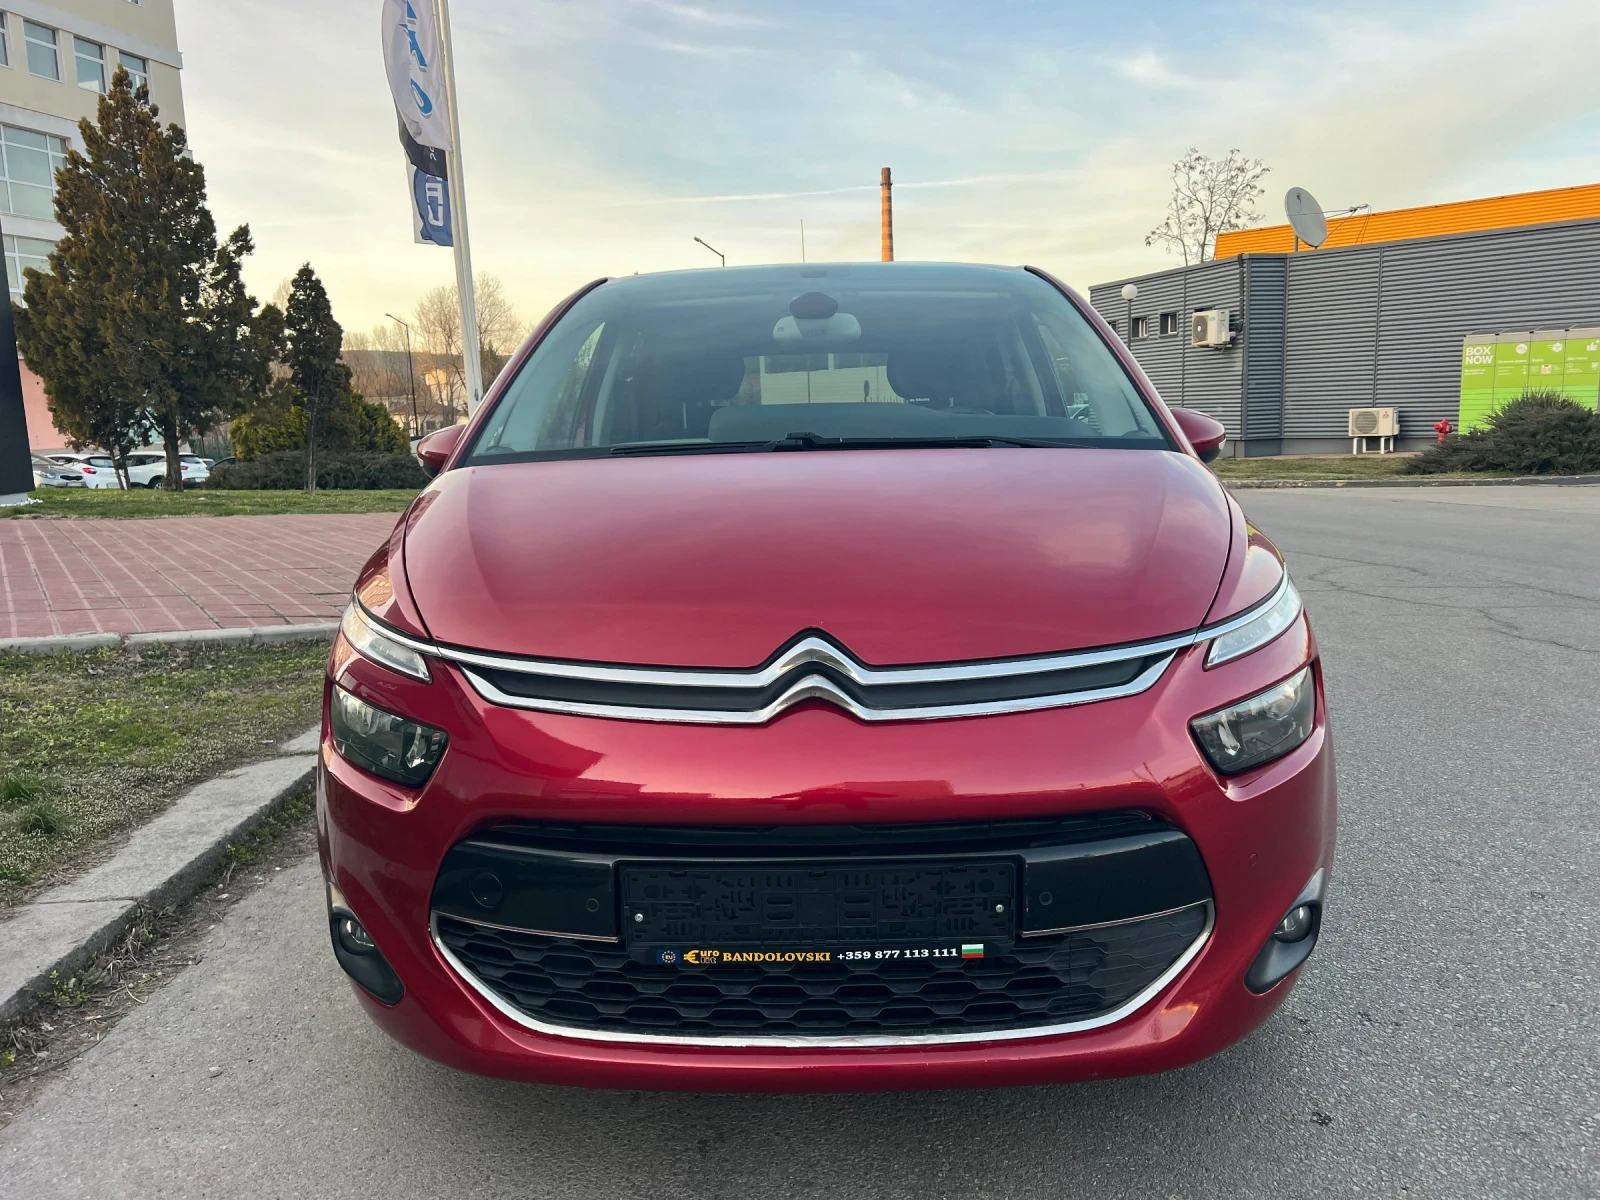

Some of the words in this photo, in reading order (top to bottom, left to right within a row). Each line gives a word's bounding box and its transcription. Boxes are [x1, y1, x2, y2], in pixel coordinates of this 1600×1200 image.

[1466, 346, 1491, 356] BOX
[1465, 355, 1493, 365] NOW
[722, 952, 831, 961] BANDOLOVSKI
[837, 950, 872, 960] +359
[874, 950, 900, 959] 877
[904, 949, 929, 958] 113
[933, 948, 958, 957] 111
